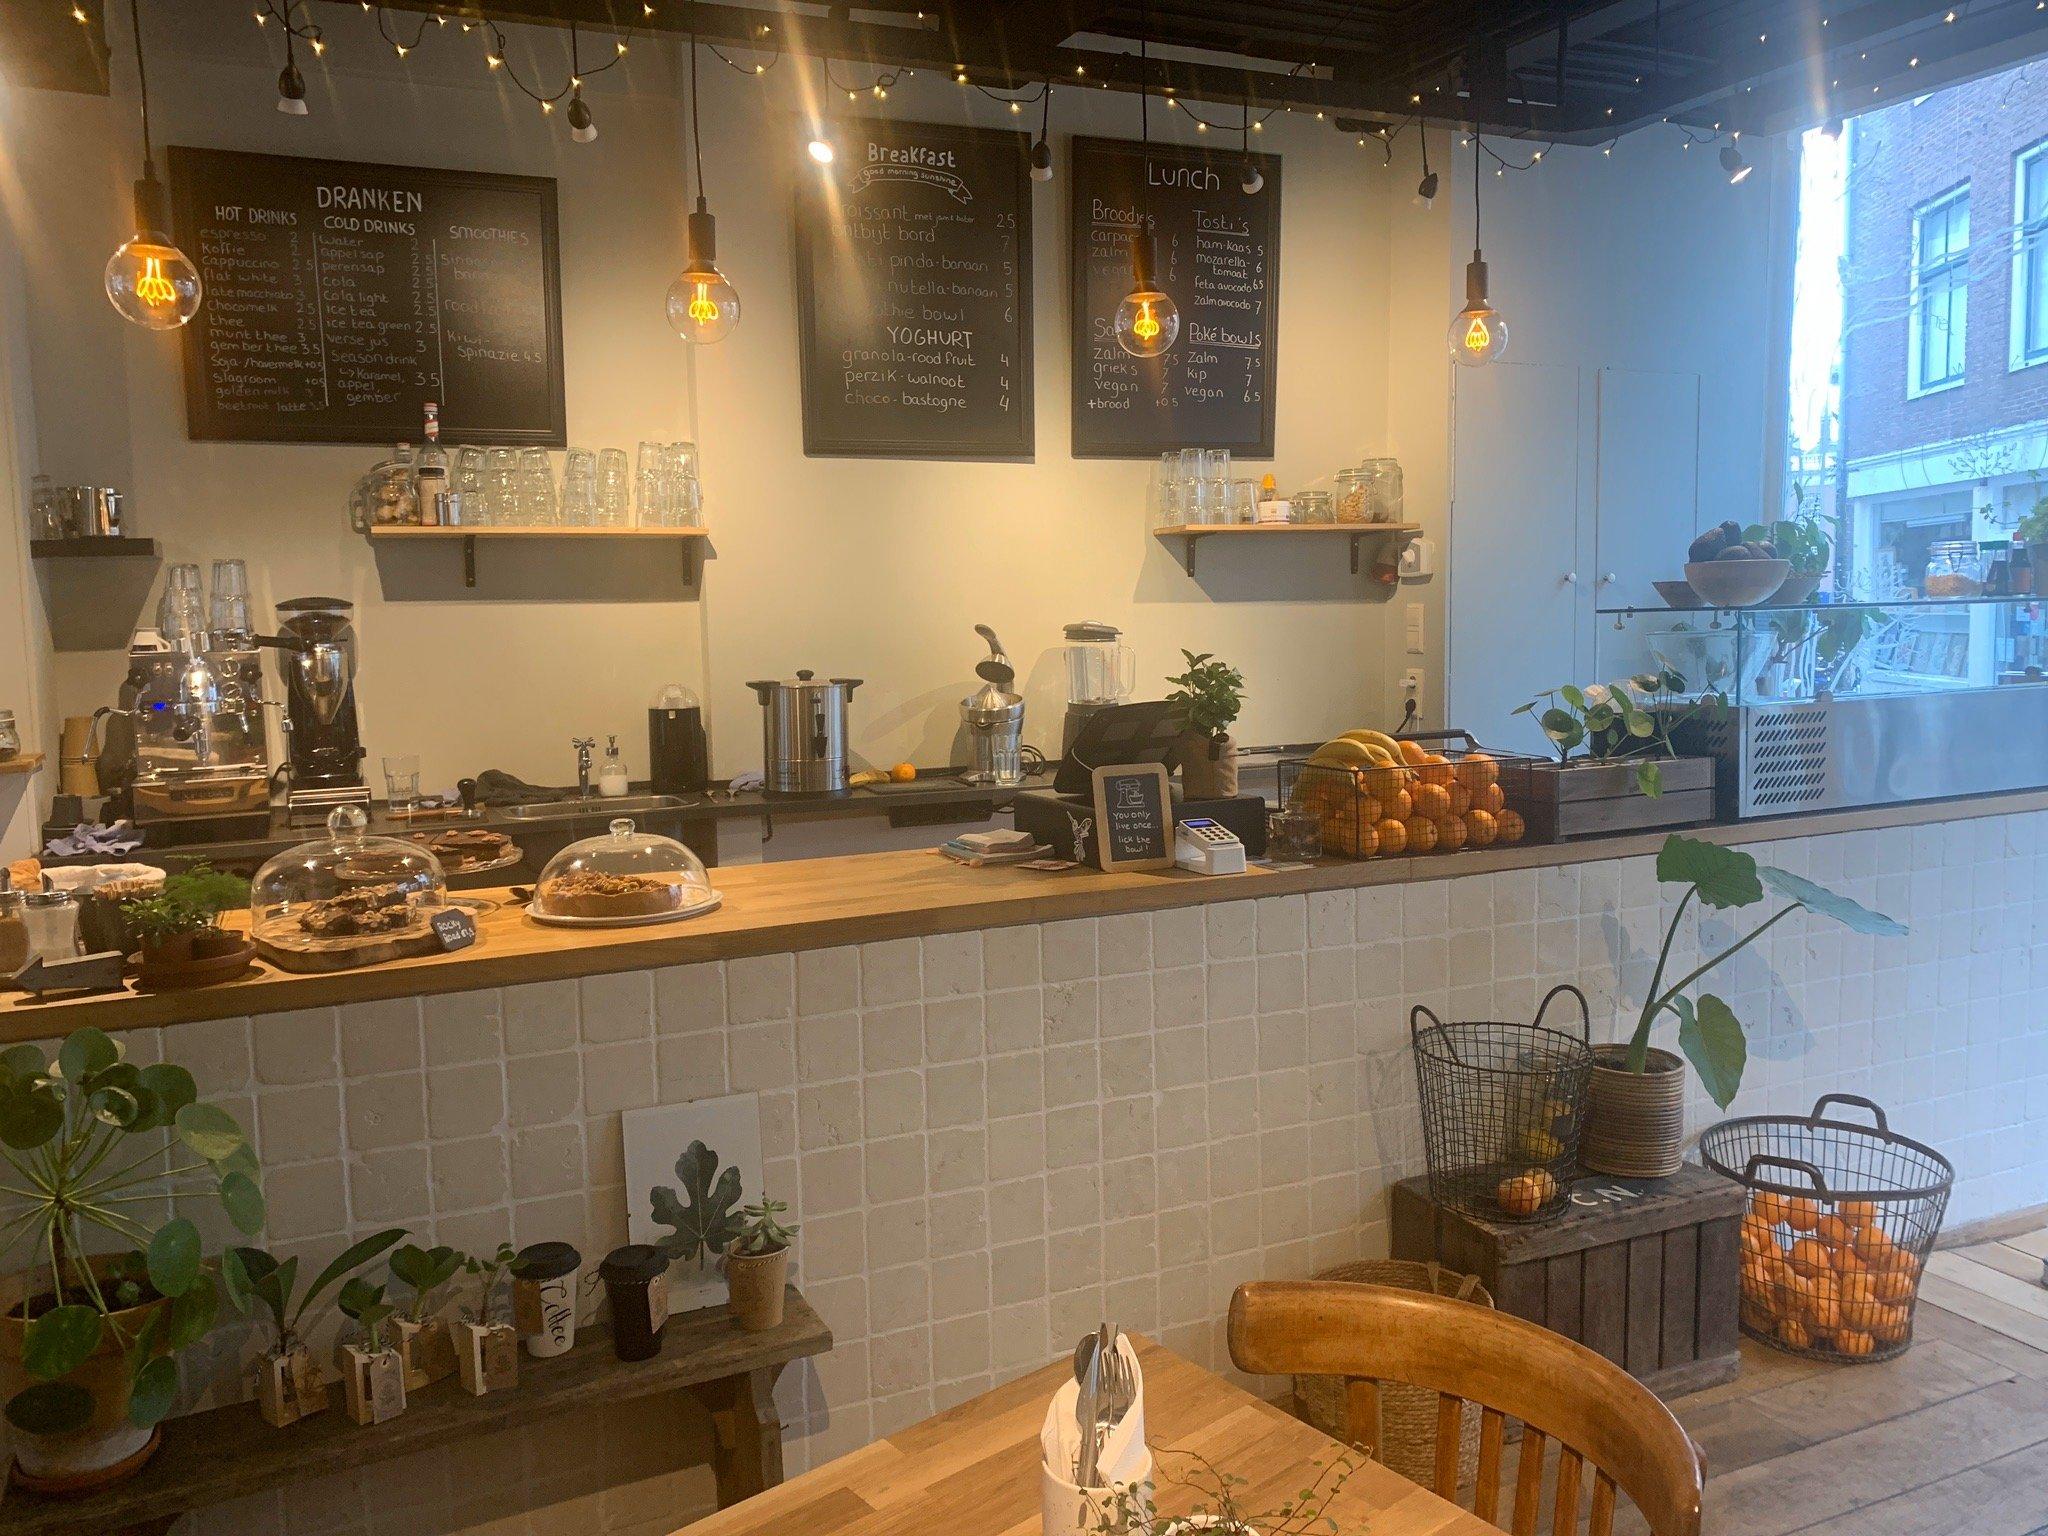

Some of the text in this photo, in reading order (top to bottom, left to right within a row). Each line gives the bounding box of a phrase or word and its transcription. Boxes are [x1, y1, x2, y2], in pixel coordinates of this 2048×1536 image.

[868, 142, 956, 168] Breakfast
[863, 168, 958, 187] good morning sunshine
[1149, 162, 1220, 191] Lunch
[317, 186, 422, 213] DRANKEN
[215, 206, 298, 226] HOT DRINKS
[841, 204, 912, 222] roissant
[1092, 198, 1156, 226] Broodjes
[323, 216, 416, 236] COLD DRINKS
[1192, 209, 1250, 234] Tosti's
[200, 228, 267, 241] espresso
[449, 225, 529, 246] SMOOTHIES
[898, 225, 936, 243] bord
[1001, 235, 1011, 253] 7
[1171, 233, 1179, 247] 6
[1170, 250, 1178, 265] 6
[1003, 261, 1012, 276] 5
[1169, 267, 1177, 282] 6
[1212, 265, 1248, 280] tomaat
[1005, 283, 1014, 299] 5
[1194, 275, 1216, 290] feta
[1217, 282, 1253, 293] avocado
[350, 305, 377, 317] tea
[922, 304, 965, 322] bowl
[1004, 307, 1013, 323] 6
[1255, 300, 1262, 316] 7
[209, 313, 246, 327] thee
[351, 319, 375, 329] tea
[209, 328, 306, 343] munt thee 3
[886, 326, 973, 349] YOGHURT
[1189, 322, 1262, 346] Poké bowls
[416, 340, 427, 353] 3
[945, 351, 976, 366] fruit
[1000, 354, 1009, 367] 4
[1162, 367, 1170, 379] 7
[1245, 374, 1252, 387] 7
[1000, 377, 1009, 390] 4
[1094, 380, 1169, 398] vegan 7
[1184, 386, 1224, 402] vegan
[1000, 395, 1009, 412] 4
[1113, 811, 1151, 820] You only
[1115, 822, 1130, 830] live
[1118, 835, 1151, 843] lick the
